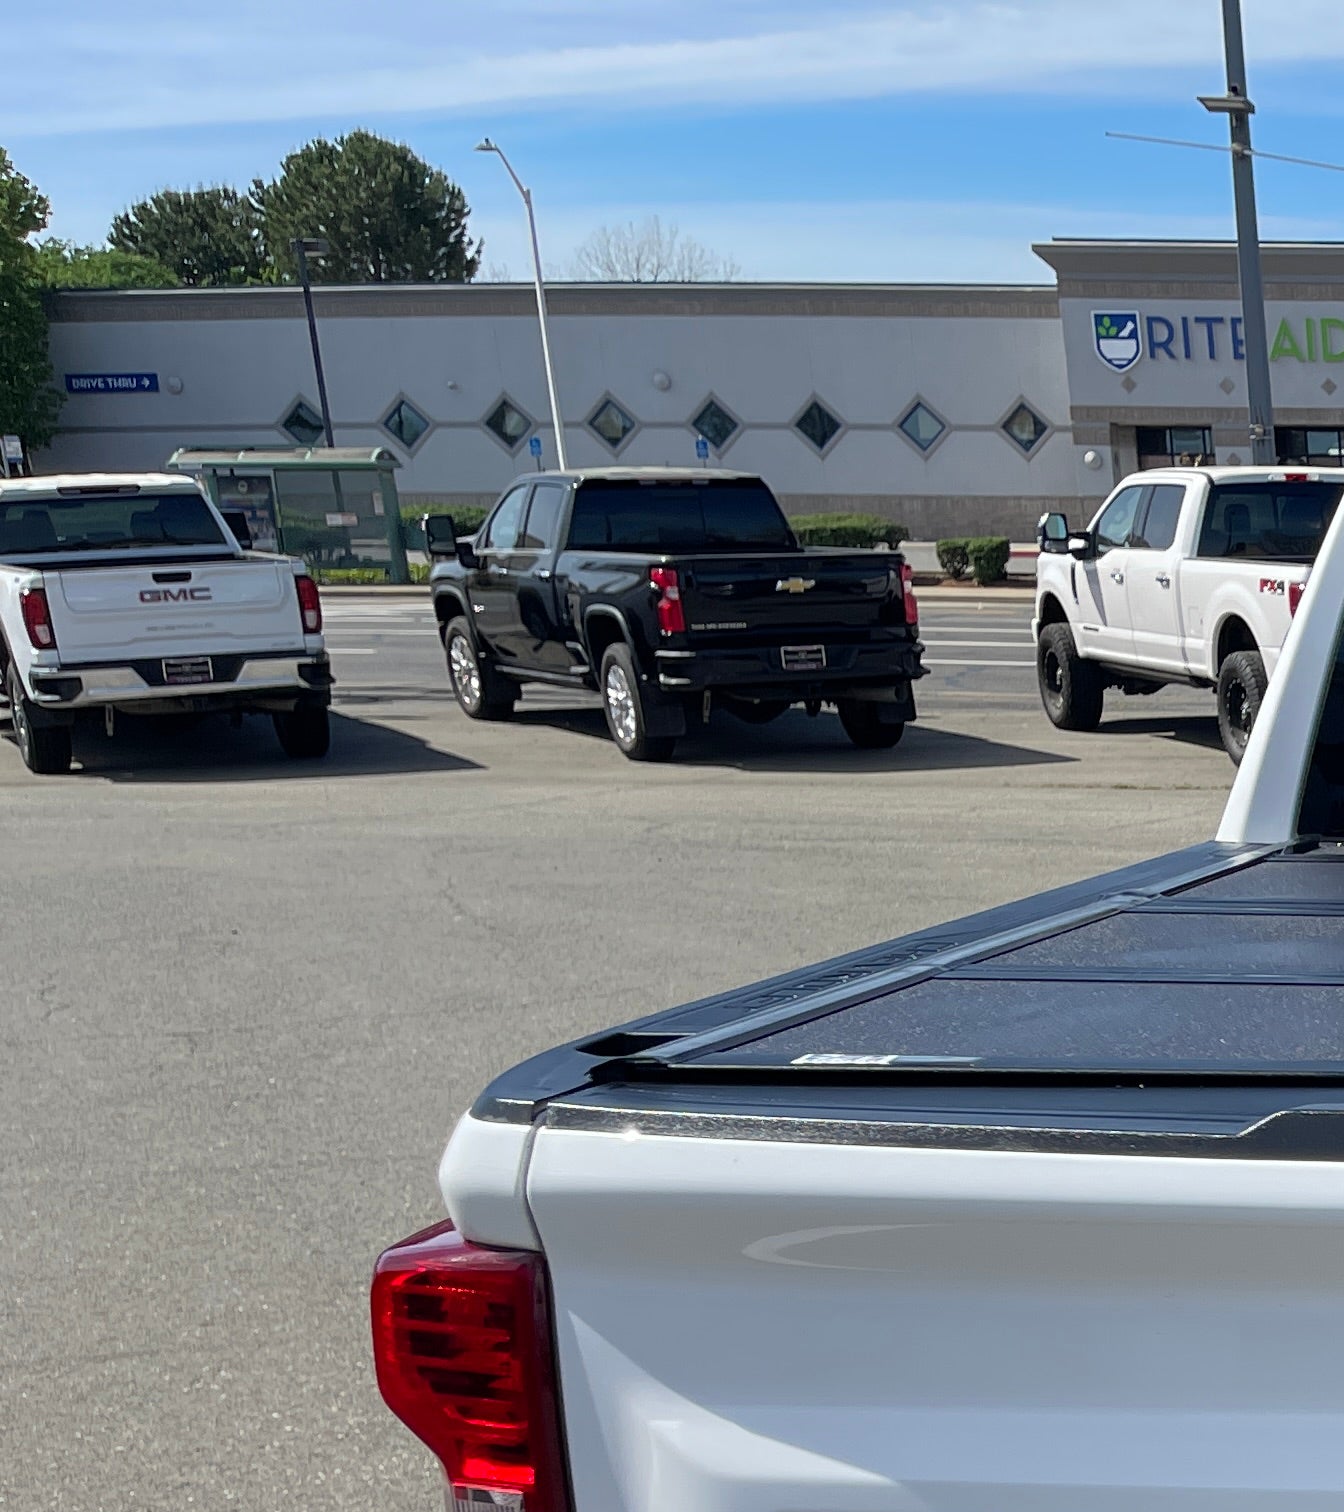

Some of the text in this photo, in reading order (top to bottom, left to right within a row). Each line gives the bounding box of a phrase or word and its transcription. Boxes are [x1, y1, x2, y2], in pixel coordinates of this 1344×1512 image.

[1146, 316, 1247, 361] RITE
[71, 377, 137, 389] DRIVE THRU
[139, 587, 213, 603] GMC
[1259, 578, 1285, 596] FX4
